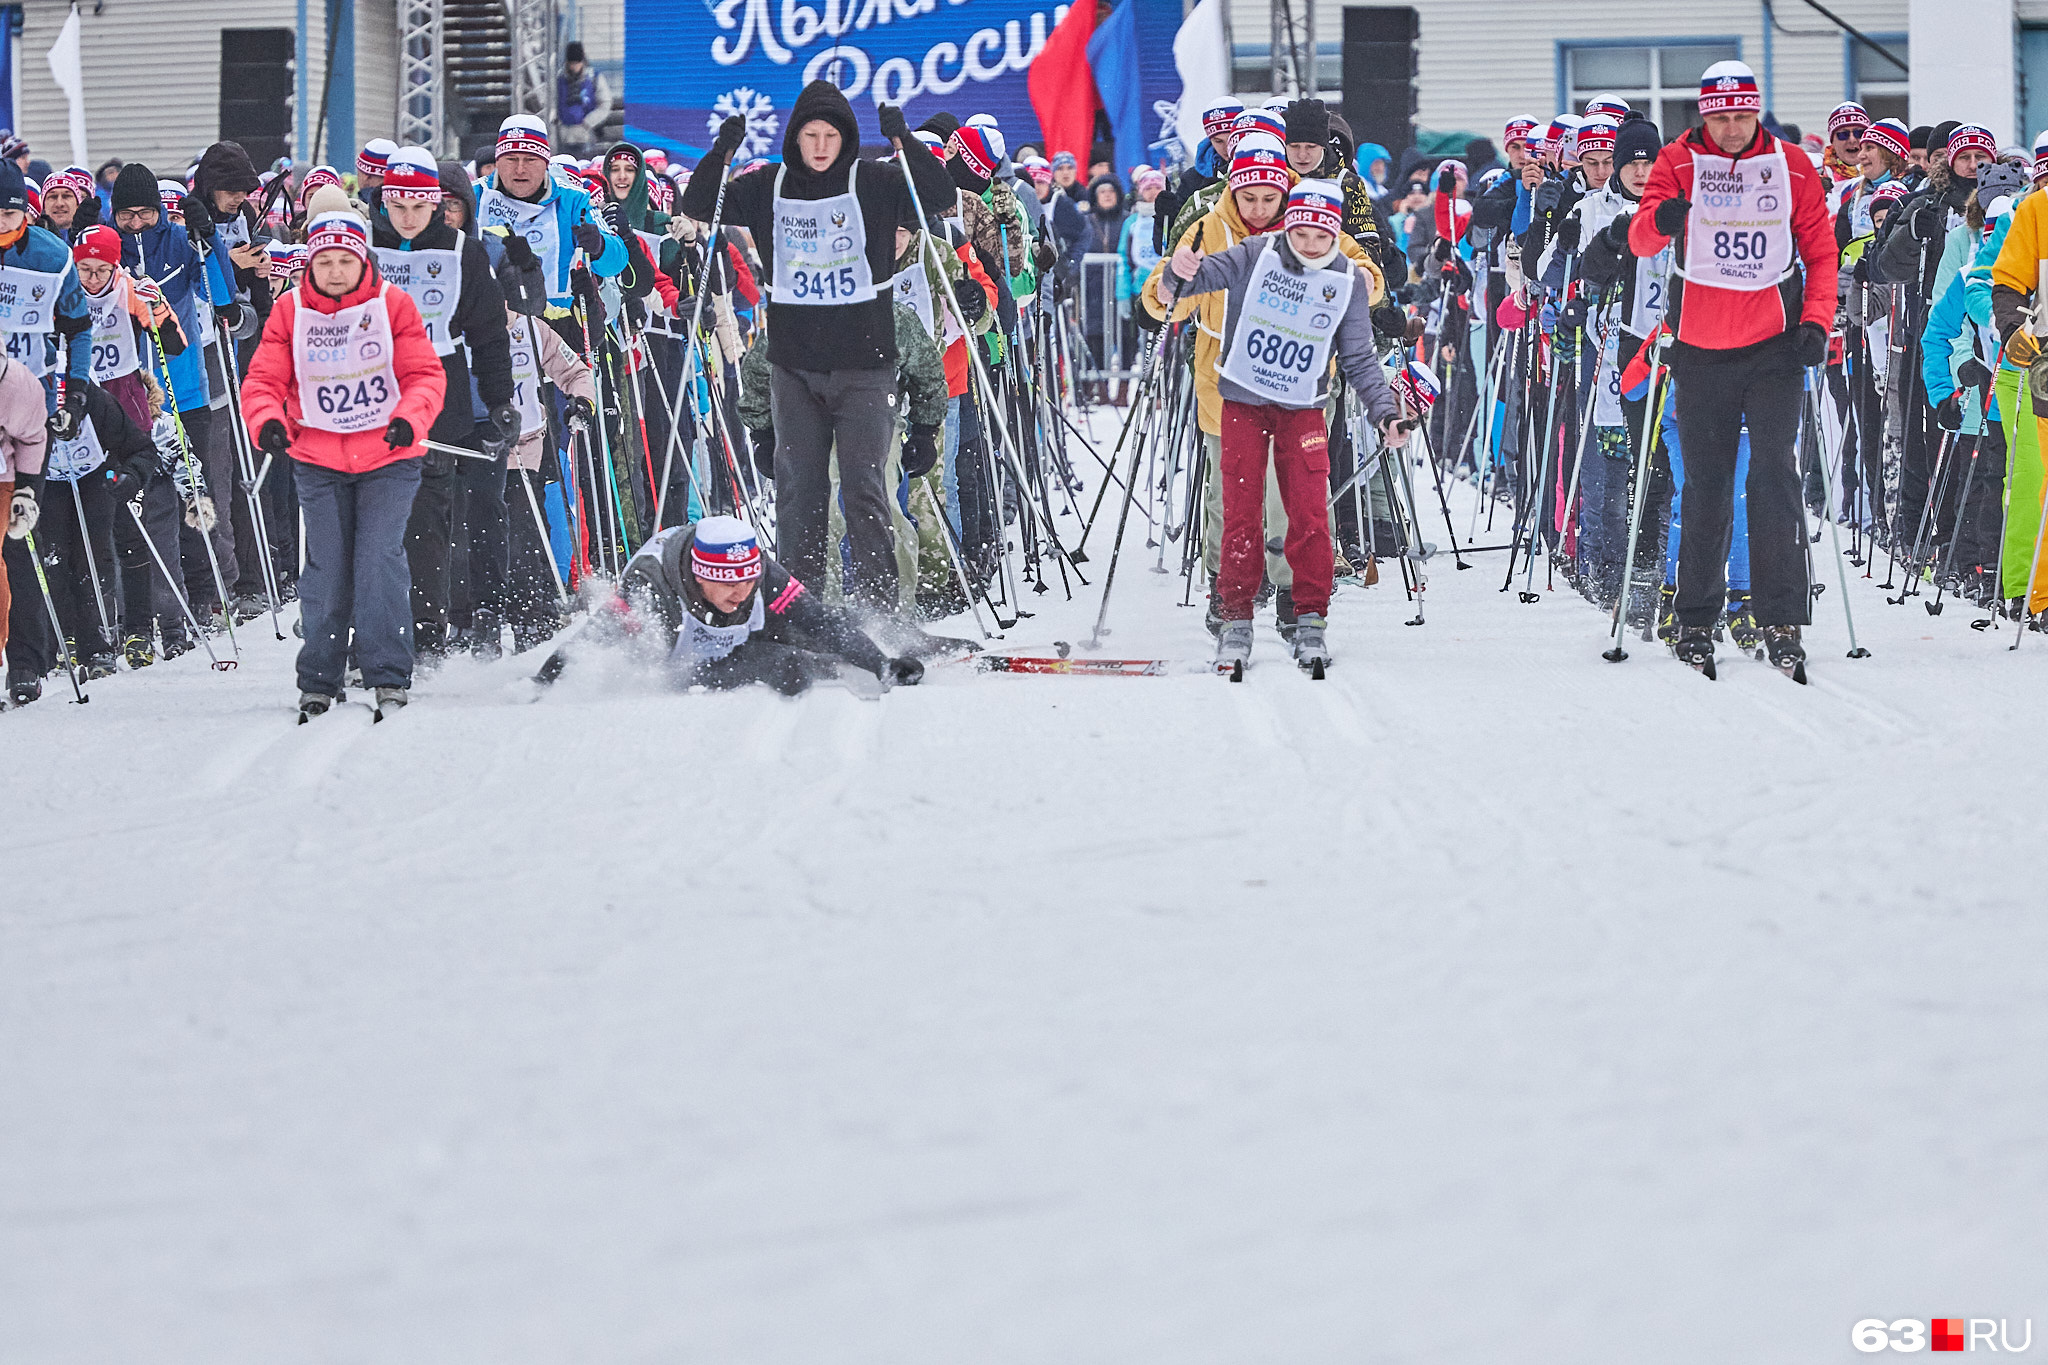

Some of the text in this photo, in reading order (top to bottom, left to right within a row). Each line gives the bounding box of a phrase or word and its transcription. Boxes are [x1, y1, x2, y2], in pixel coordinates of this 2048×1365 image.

[803, 4, 1072, 112] Росси
[1866, 131, 1902, 154] РОССИИ
[1700, 170, 1744, 182] ЛЫЖНЯ
[1700, 182, 1744, 193] РОССИИ
[1714, 231, 1767, 260] 850
[793, 266, 856, 299] 3415
[1265, 270, 1308, 292] ЛЫЖНЯ
[1721, 268, 1757, 278] ОБЛАСТЬ
[1261, 279, 1305, 303] РОССИИ
[1645, 282, 1662, 309] 2
[1258, 291, 1300, 316] 2023
[307, 325, 350, 337] ЛЫЖНЯ
[307, 336, 348, 348] РОССИИ
[91, 343, 120, 372] 29
[1247, 328, 1314, 372] 6809
[1252, 365, 1299, 384] САМАРСКАЯ
[1254, 376, 1289, 392] ОБЛАСТЬ
[1989, 362, 2002, 395] MADSHUS
[317, 375, 388, 414] 6243
